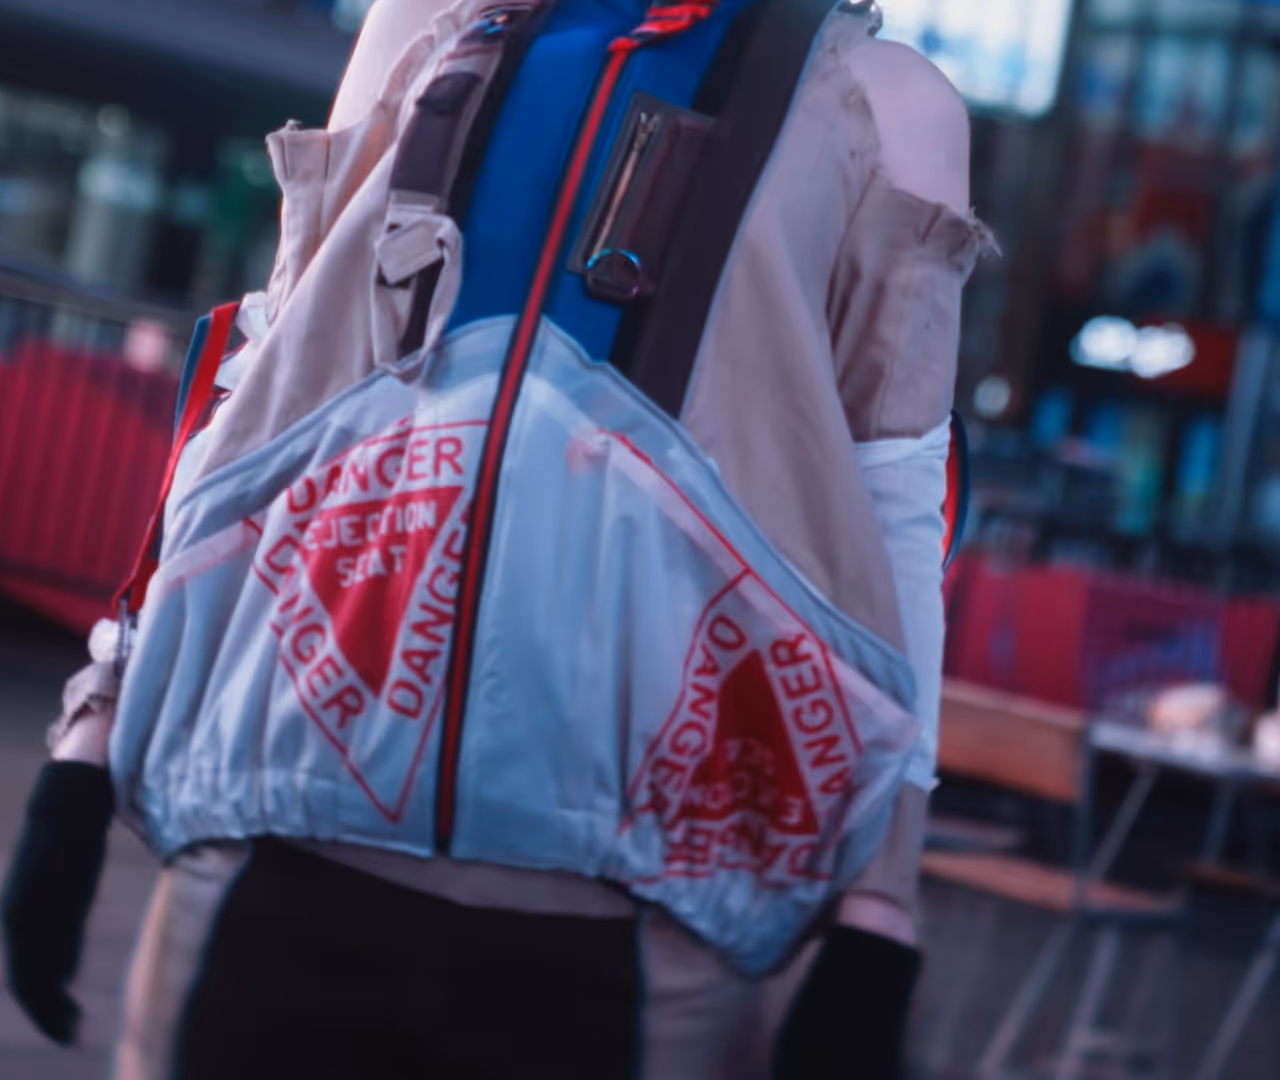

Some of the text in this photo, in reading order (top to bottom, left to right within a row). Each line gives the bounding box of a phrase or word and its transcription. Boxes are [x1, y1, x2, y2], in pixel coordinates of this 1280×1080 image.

[304, 499, 436, 550] EJECTION
[336, 545, 407, 588] SEAT
[386, 506, 467, 720] DANGE
[263, 534, 366, 730] DNGER
[642, 613, 748, 813] DANGE
[769, 632, 853, 796] ANGER
